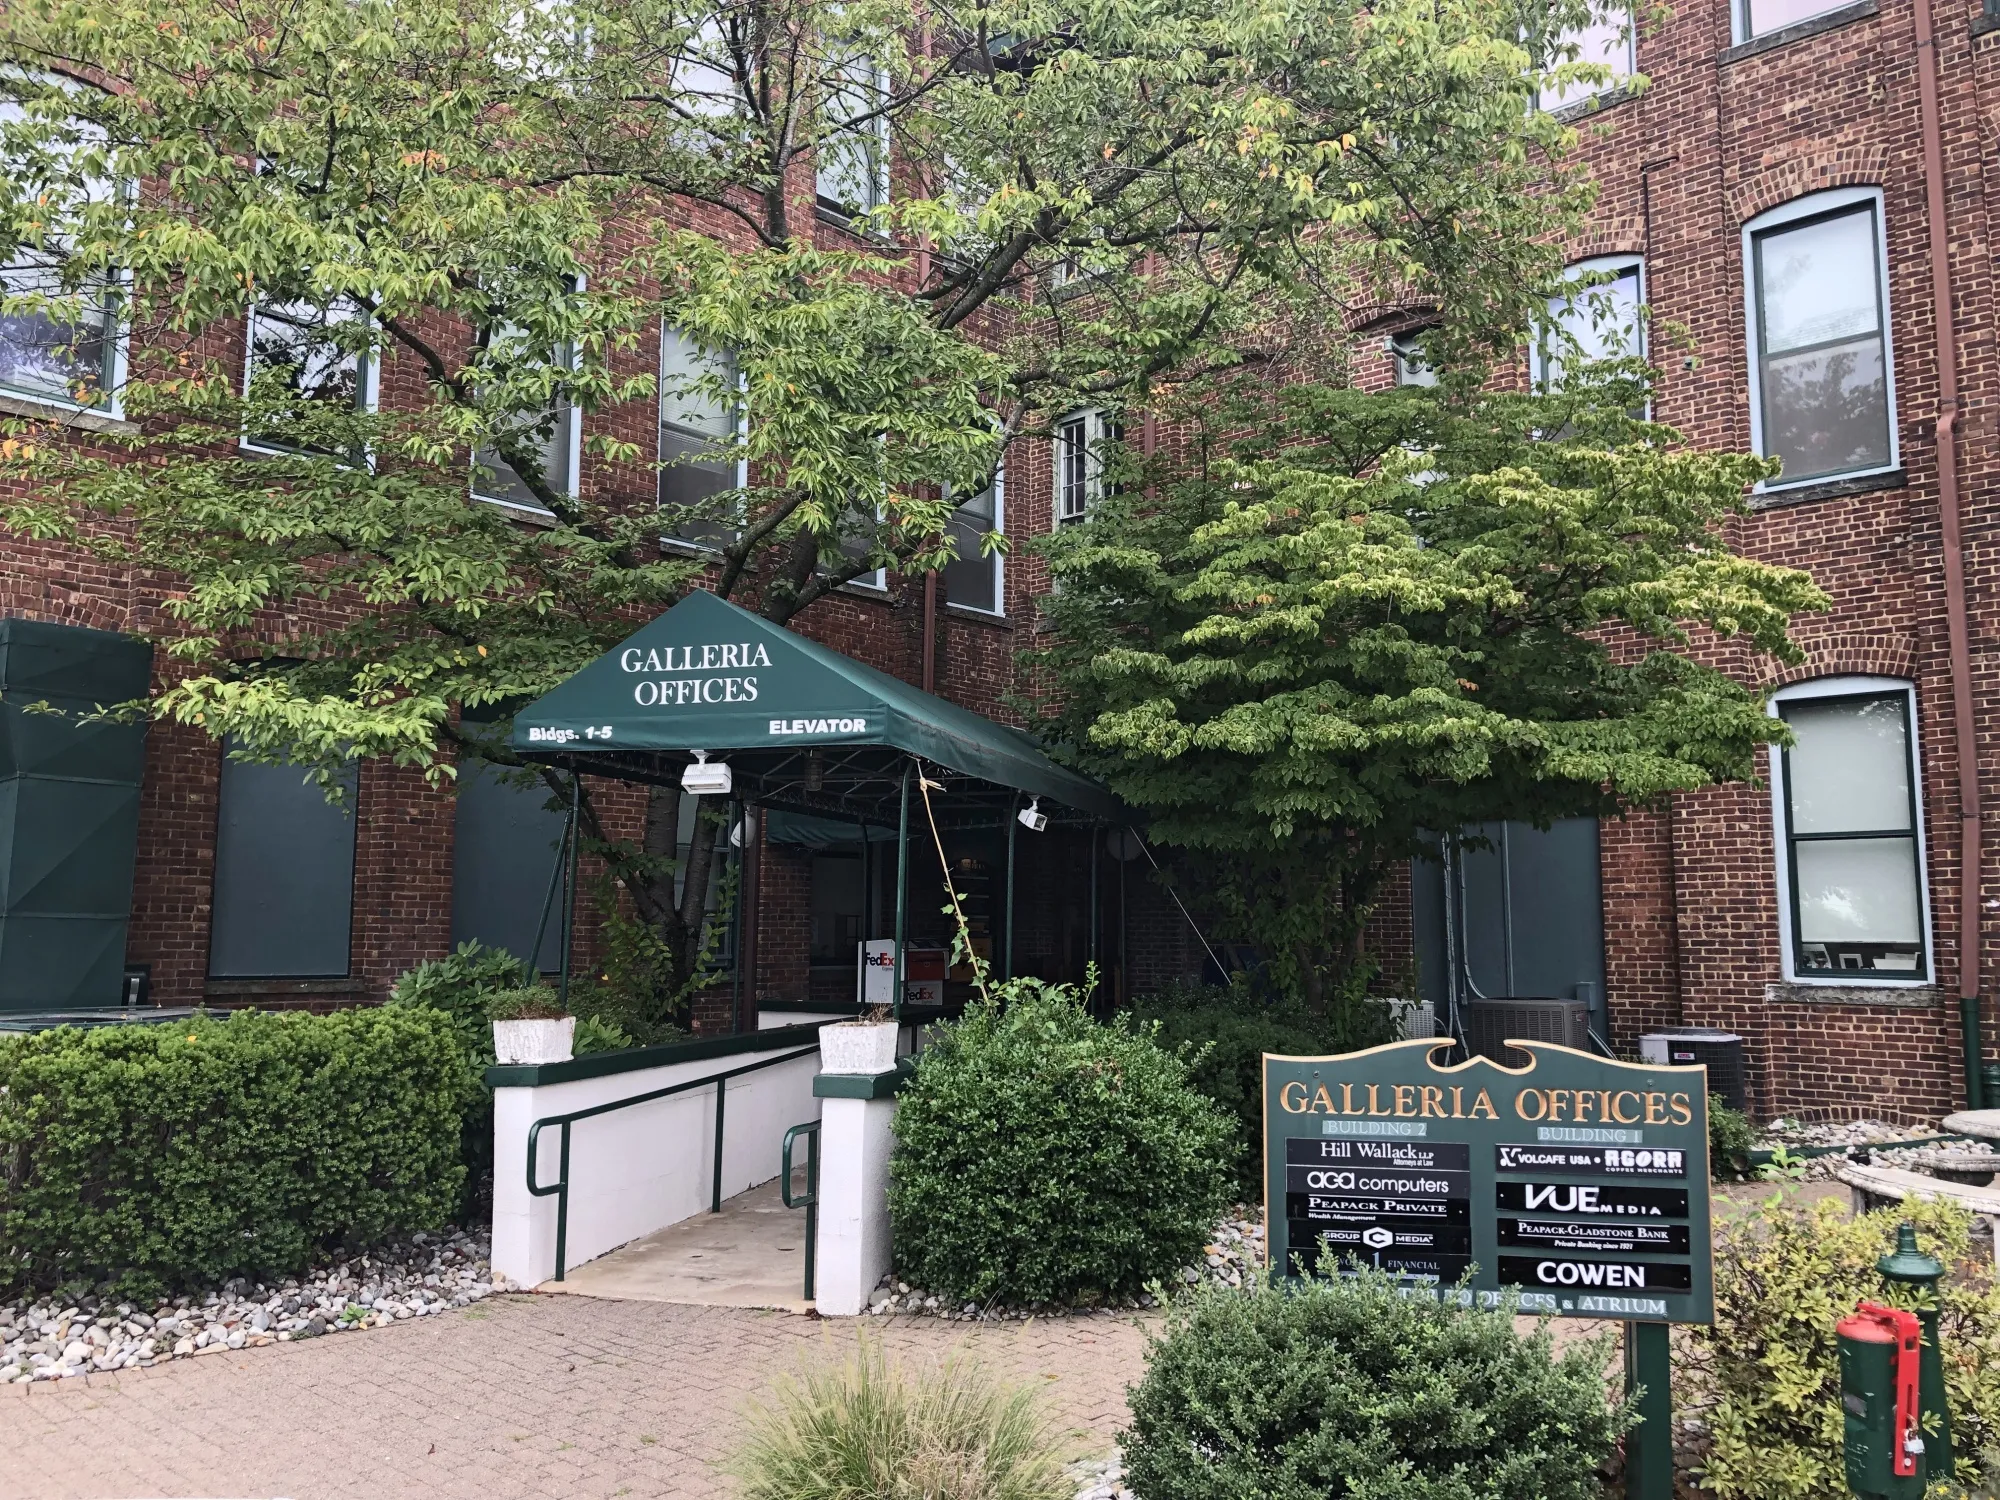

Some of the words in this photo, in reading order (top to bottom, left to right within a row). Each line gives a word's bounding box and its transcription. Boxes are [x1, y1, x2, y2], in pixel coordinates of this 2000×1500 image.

[621, 643, 772, 673] GALLERIA
[634, 677, 758, 706] OFFICES
[529, 727, 579, 743] Bldgs.
[585, 725, 612, 739] 1-5
[769, 718, 866, 735] ELEVATOR
[865, 952, 895, 966] FedEx
[1279, 1081, 1500, 1120] GALLERIA
[1515, 1088, 1692, 1126] OFFICES
[1327, 1120, 1411, 1135] BUILDING
[1417, 1122, 1427, 1136] 2
[1538, 1127, 1626, 1143] BUILDING
[1633, 1130, 1641, 1143] 1
[1320, 1142, 1351, 1157] Hill
[1356, 1142, 1417, 1159] Wallack
[1418, 1152, 1435, 1160] LLP
[1518, 1154, 1566, 1165] VOLCAFE
[1569, 1155, 1592, 1165] USA
[1359, 1176, 1449, 1194] computers
[1308, 1197, 1379, 1211] PEAPACK
[1383, 1200, 1447, 1213] PRIVATE
[1525, 1184, 1600, 1213] VUE
[1600, 1203, 1662, 1215] MEDIA
[1308, 1212, 1331, 1220] Wealth
[1332, 1213, 1377, 1221] Management
[1323, 1232, 1360, 1240] GROUP
[1518, 1221, 1634, 1238] PEAPACK-GLADSTONE
[1637, 1227, 1669, 1239] BANK
[1554, 1239, 1577, 1248] Private
[1577, 1240, 1602, 1250] Banking
[1619, 1242, 1633, 1250] 1921
[1387, 1260, 1440, 1270] FINANCIAL
[1536, 1261, 1645, 1288] COWEN
[1562, 1299, 1574, 1310] &
[1582, 1295, 1667, 1315] ATRIUM
